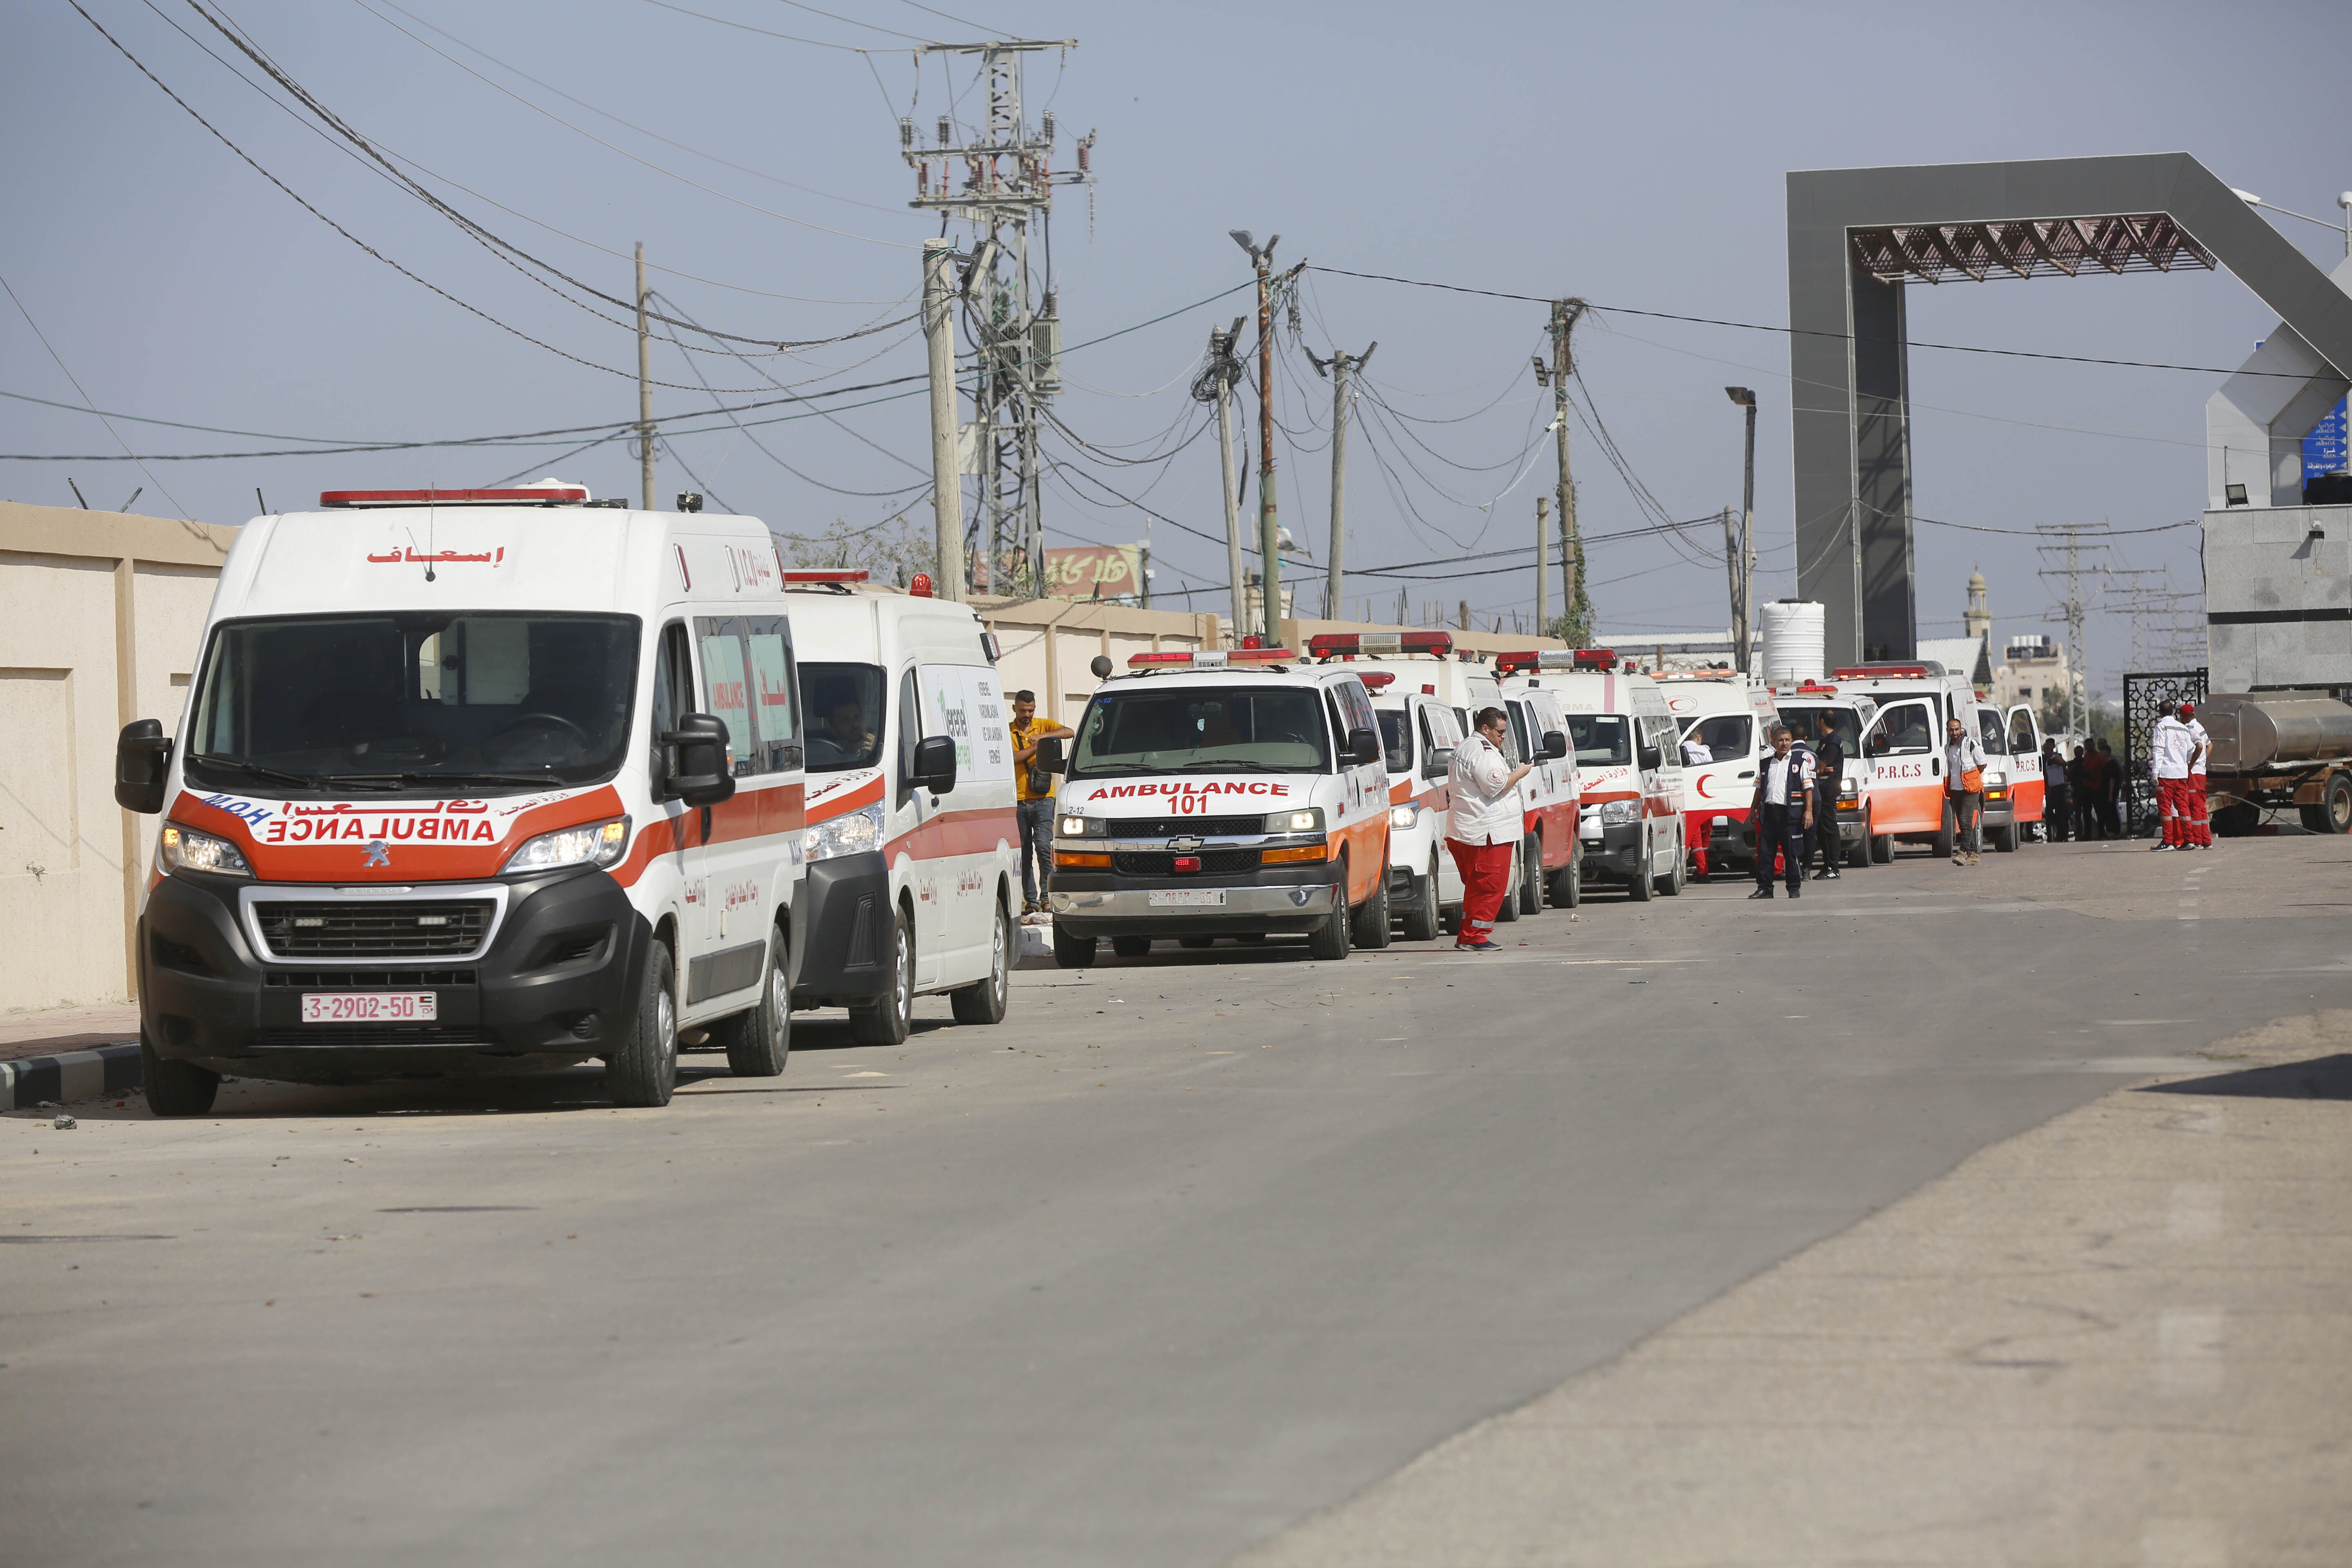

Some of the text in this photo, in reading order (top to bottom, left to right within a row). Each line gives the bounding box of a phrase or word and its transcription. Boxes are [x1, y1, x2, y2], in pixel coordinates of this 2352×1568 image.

[367, 546, 505, 569] إسعاف
[1095, 697, 1113, 705] 2-12
[1605, 767, 1628, 778] وزارة
[1878, 764, 1921, 779] P.R.C.S
[2016, 759, 2035, 773] P.R.C.S
[1580, 773, 1608, 791] الصحة
[1087, 782, 1290, 801] AMBULANCE
[199, 794, 274, 826] M.O.H
[494, 791, 569, 816] وزارة الصحة
[1068, 806, 1084, 815] 2-12
[1167, 795, 1207, 814] 101
[309, 996, 414, 1018] 3-2902-50
